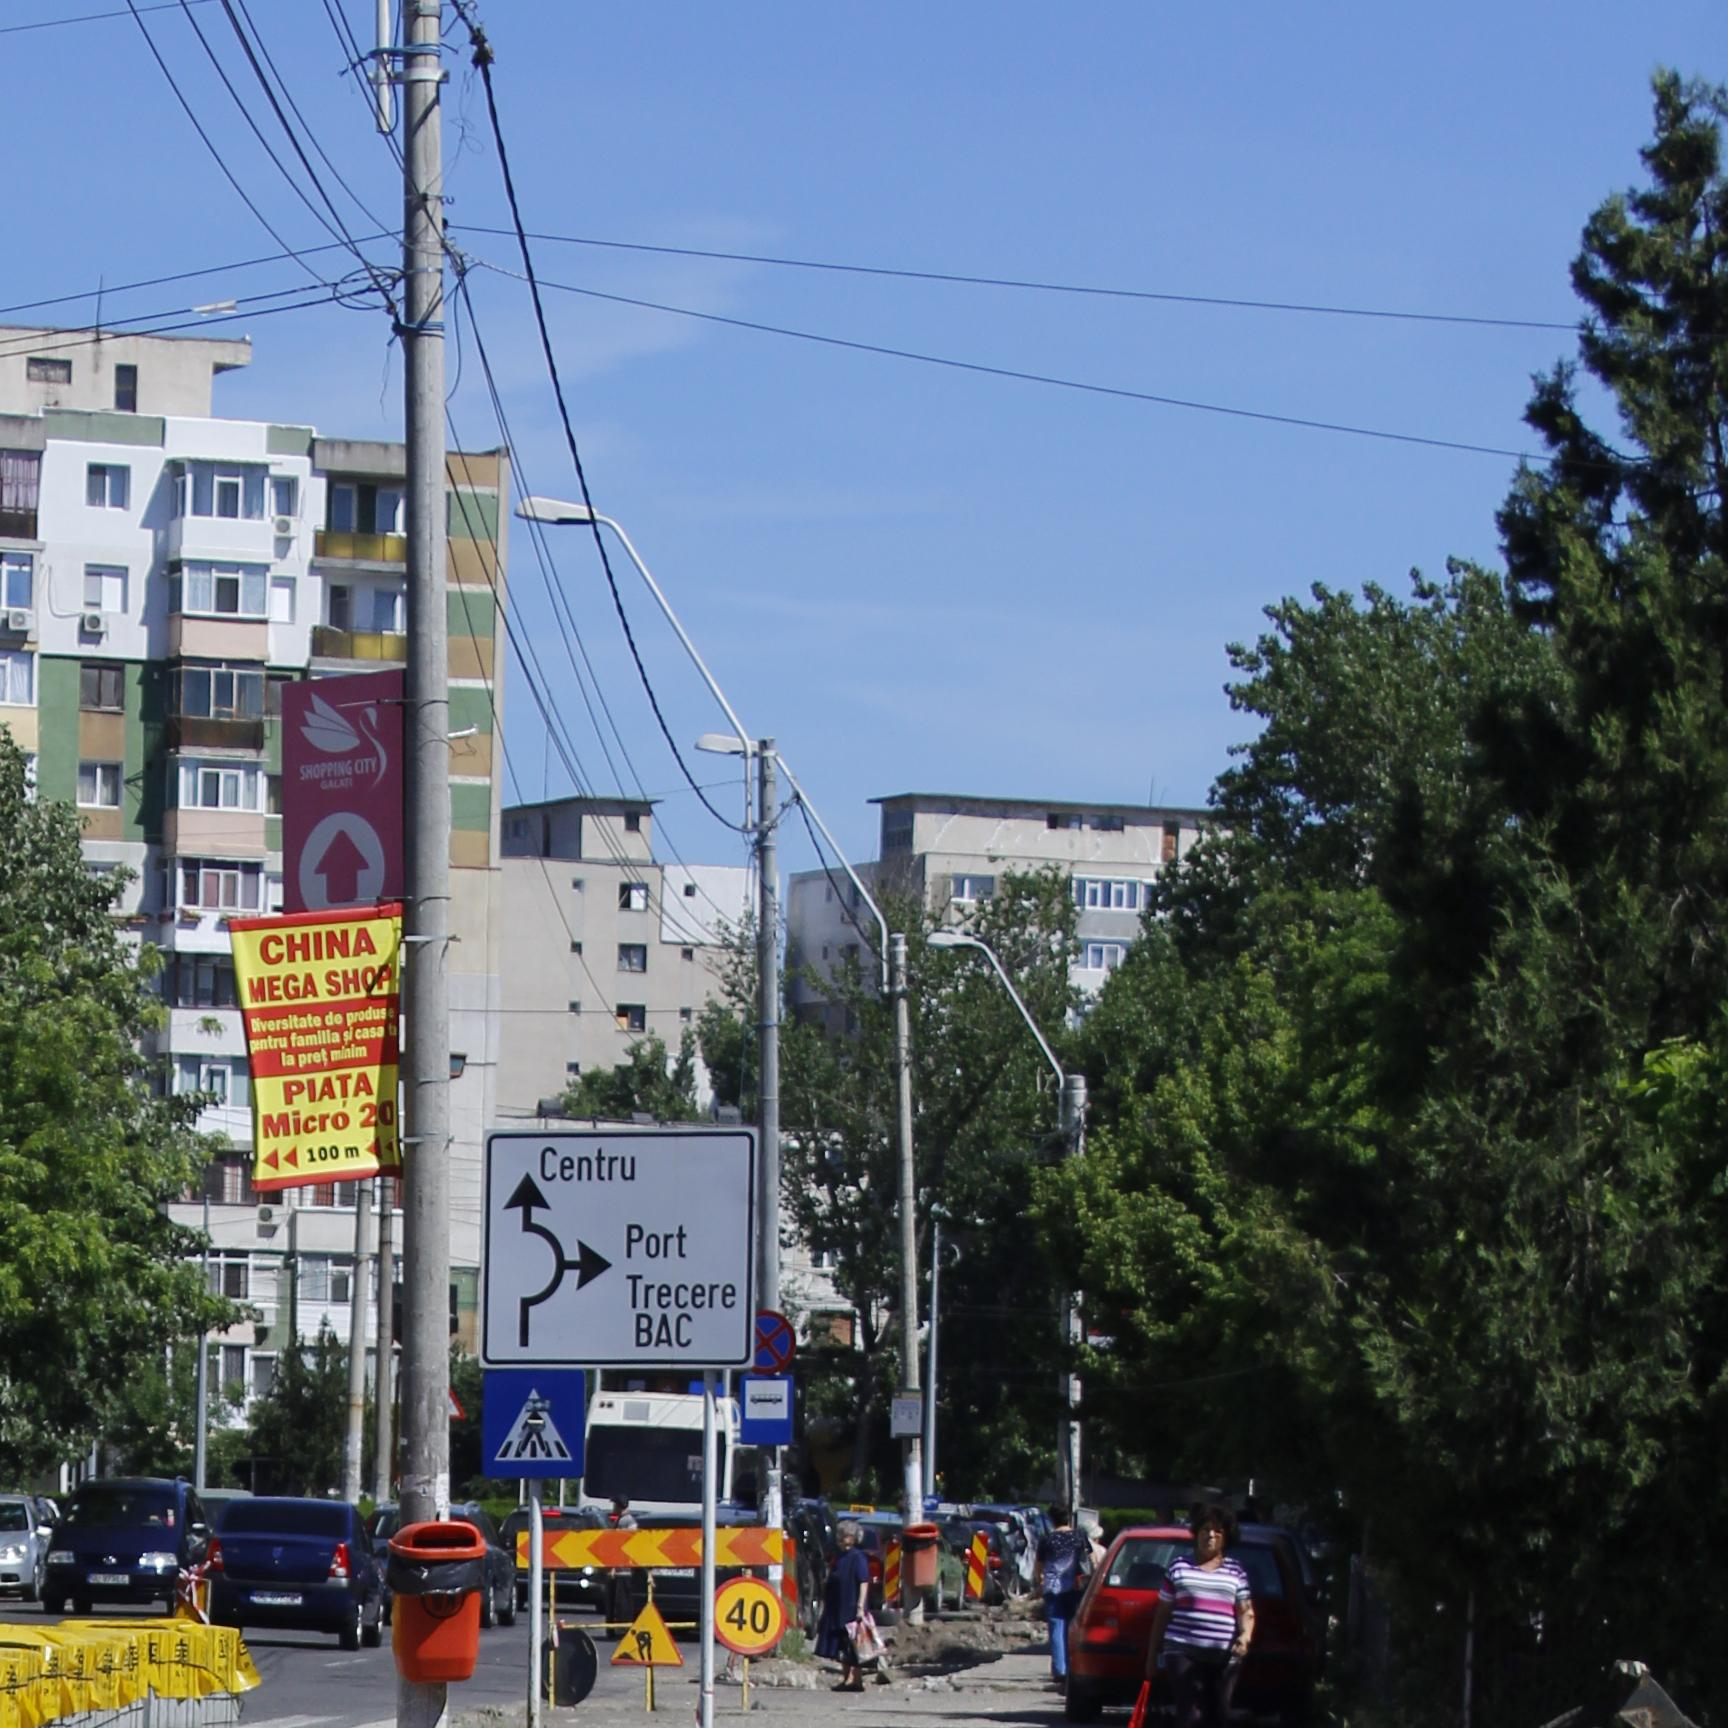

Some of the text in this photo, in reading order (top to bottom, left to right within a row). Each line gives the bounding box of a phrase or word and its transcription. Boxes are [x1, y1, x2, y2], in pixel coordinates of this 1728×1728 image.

[299, 757, 377, 780] SHOPPING CITY
[259, 927, 377, 966] CHINA
[248, 964, 393, 1004] MEGA SHOP
[251, 1006, 394, 1032] Diversitate de produse
[290, 1029, 340, 1047] familia
[355, 1026, 385, 1040] casa
[281, 1044, 368, 1068] la preț minim
[283, 1072, 375, 1107] PIAȚA
[262, 1100, 395, 1139] Micro 20
[307, 1145, 360, 1162] 100 m
[539, 1146, 636, 1182] Centru
[625, 1224, 687, 1259] Port
[625, 1274, 737, 1309] Trecere
[634, 1312, 693, 1348] BAC
[725, 1597, 770, 1635] 40
